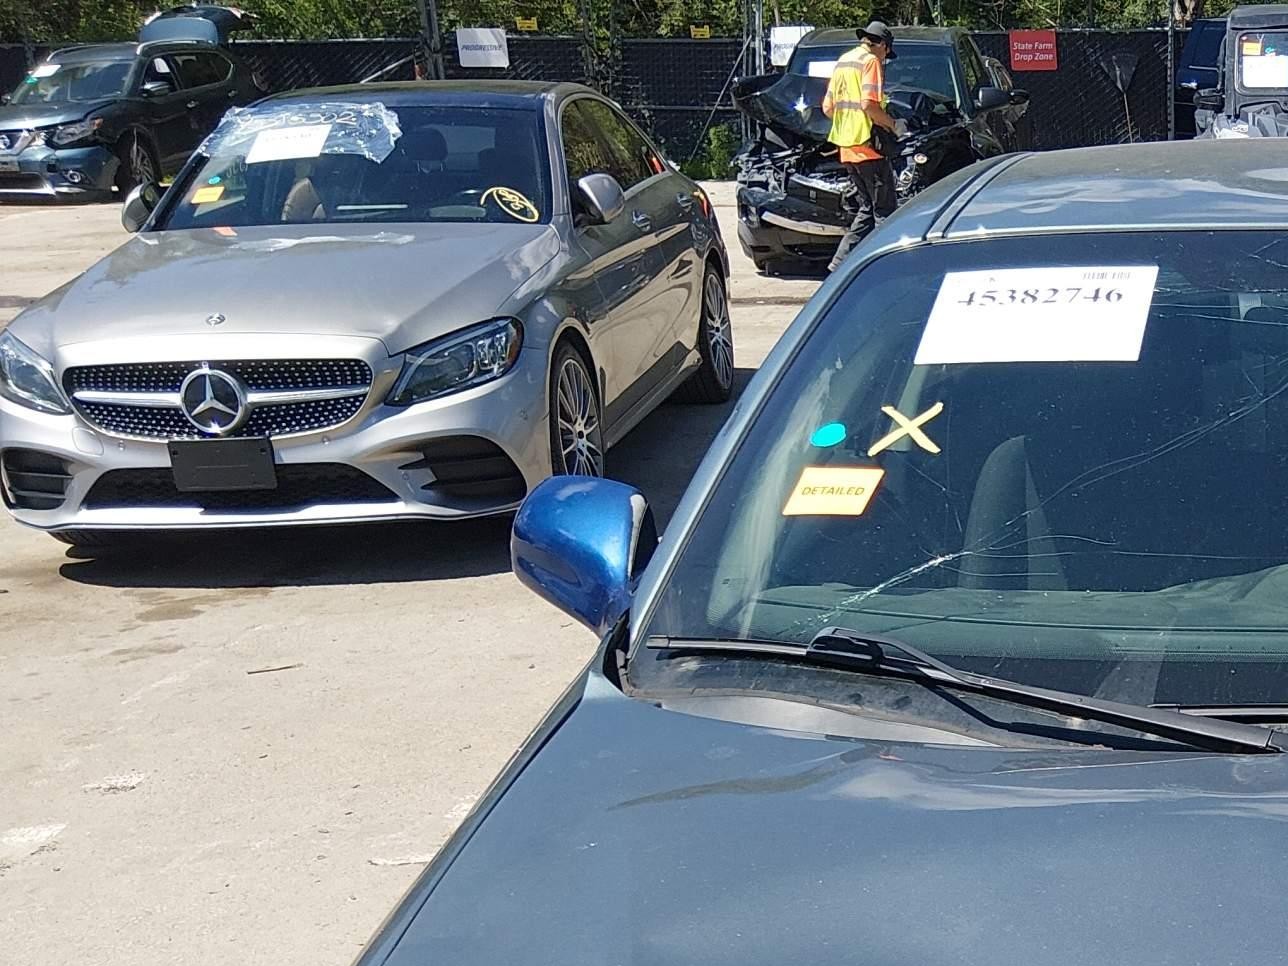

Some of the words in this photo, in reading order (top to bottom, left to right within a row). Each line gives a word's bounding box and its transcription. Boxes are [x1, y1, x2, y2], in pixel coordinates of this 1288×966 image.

[1035, 41, 1053, 49] Farm
[1014, 53, 1033, 62] Drop
[957, 287, 1124, 306] 45382746
[801, 486, 865, 496] DETAILED
